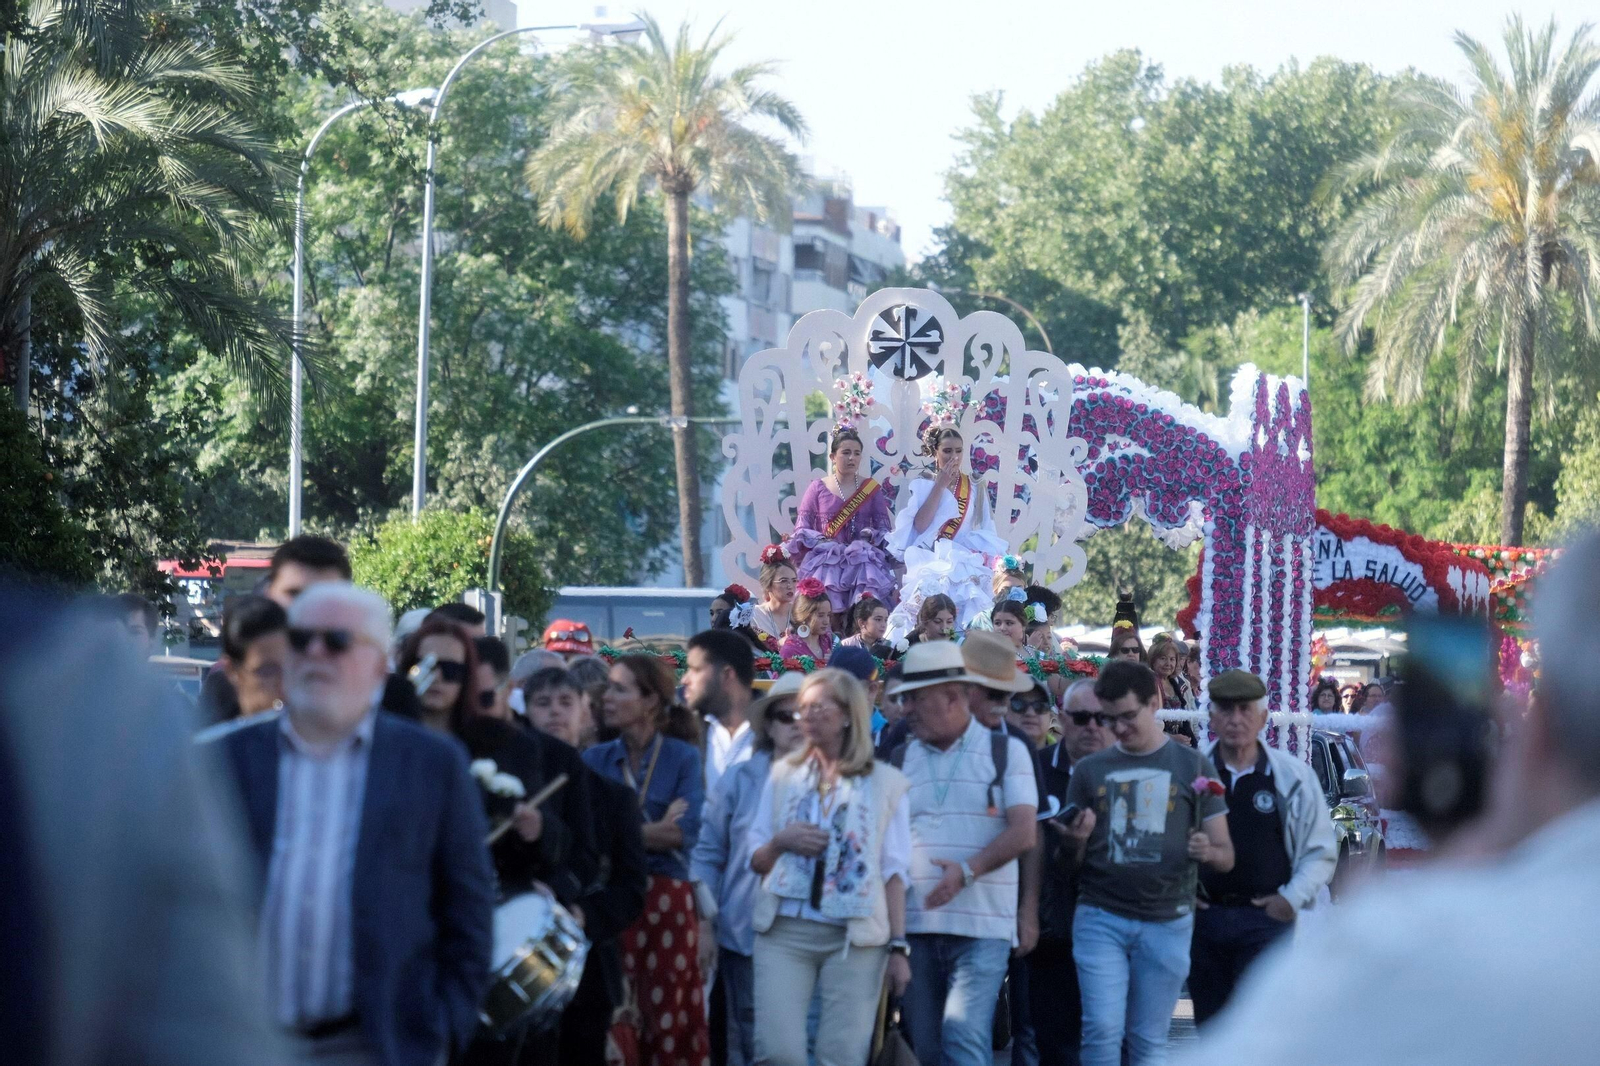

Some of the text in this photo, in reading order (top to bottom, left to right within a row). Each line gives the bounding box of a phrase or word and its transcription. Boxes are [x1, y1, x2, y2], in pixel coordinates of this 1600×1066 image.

[842, 488, 869, 514] INFANTIL
[1332, 560, 1354, 581] LA
[1364, 560, 1427, 602] SALUD
